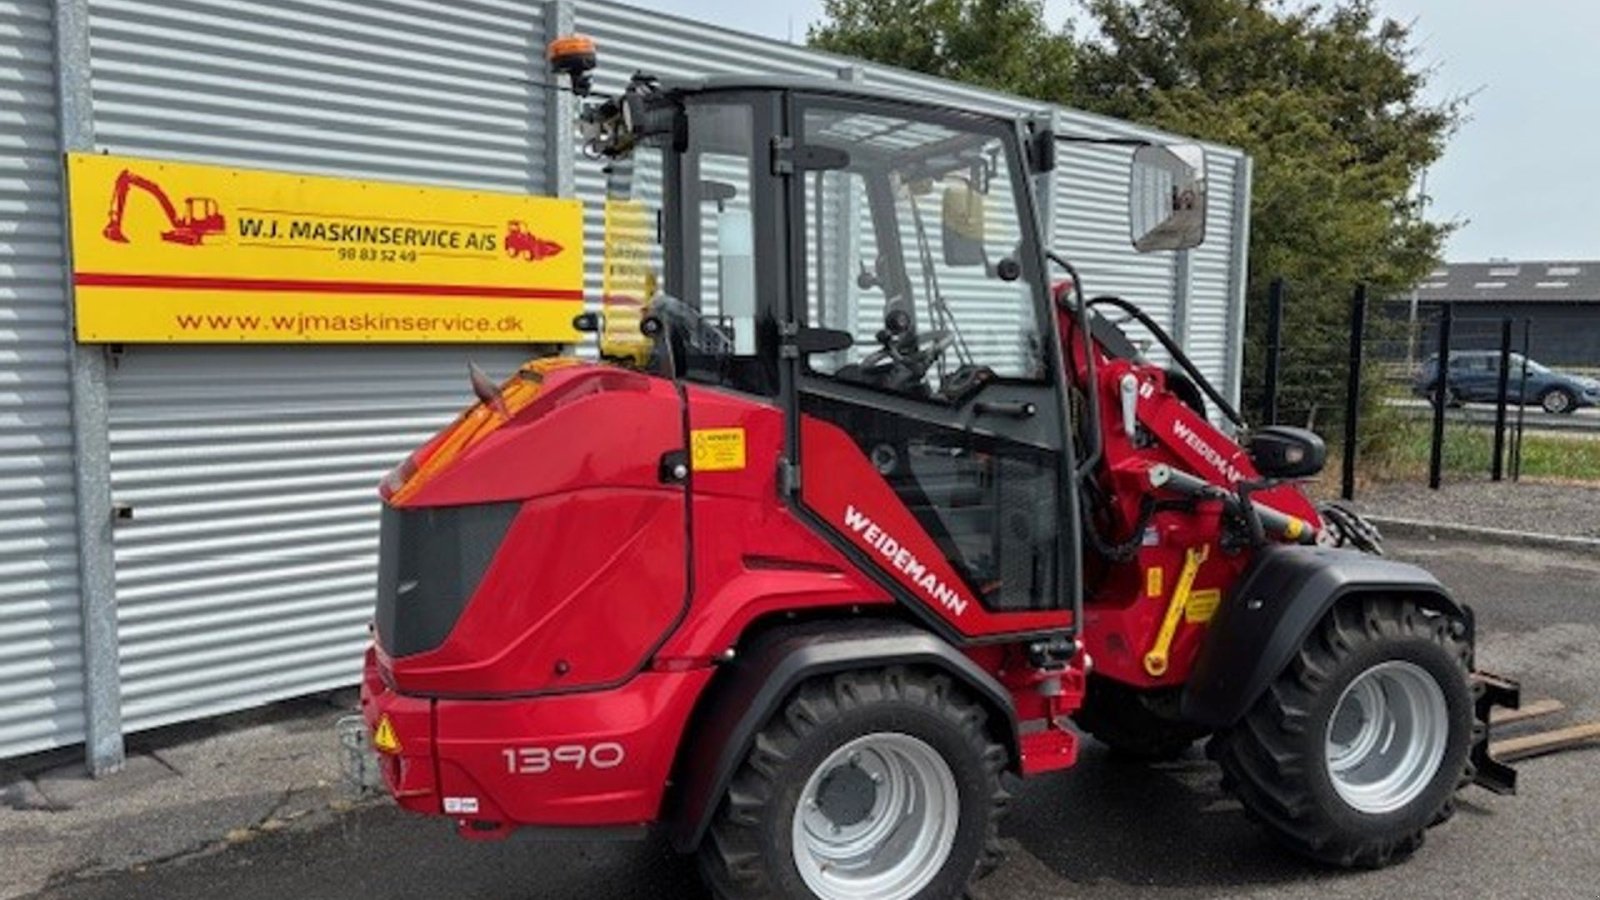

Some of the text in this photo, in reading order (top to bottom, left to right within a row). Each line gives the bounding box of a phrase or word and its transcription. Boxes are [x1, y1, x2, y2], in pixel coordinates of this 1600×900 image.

[238, 218, 497, 251] W.J. MASKINSERVICE A/S
[338, 247, 416, 263] 98 83 52 49
[176, 313, 524, 335] www.wjmaskinservice.dk
[844, 504, 968, 617] WEIDEMANN
[502, 742, 625, 774] 1390
